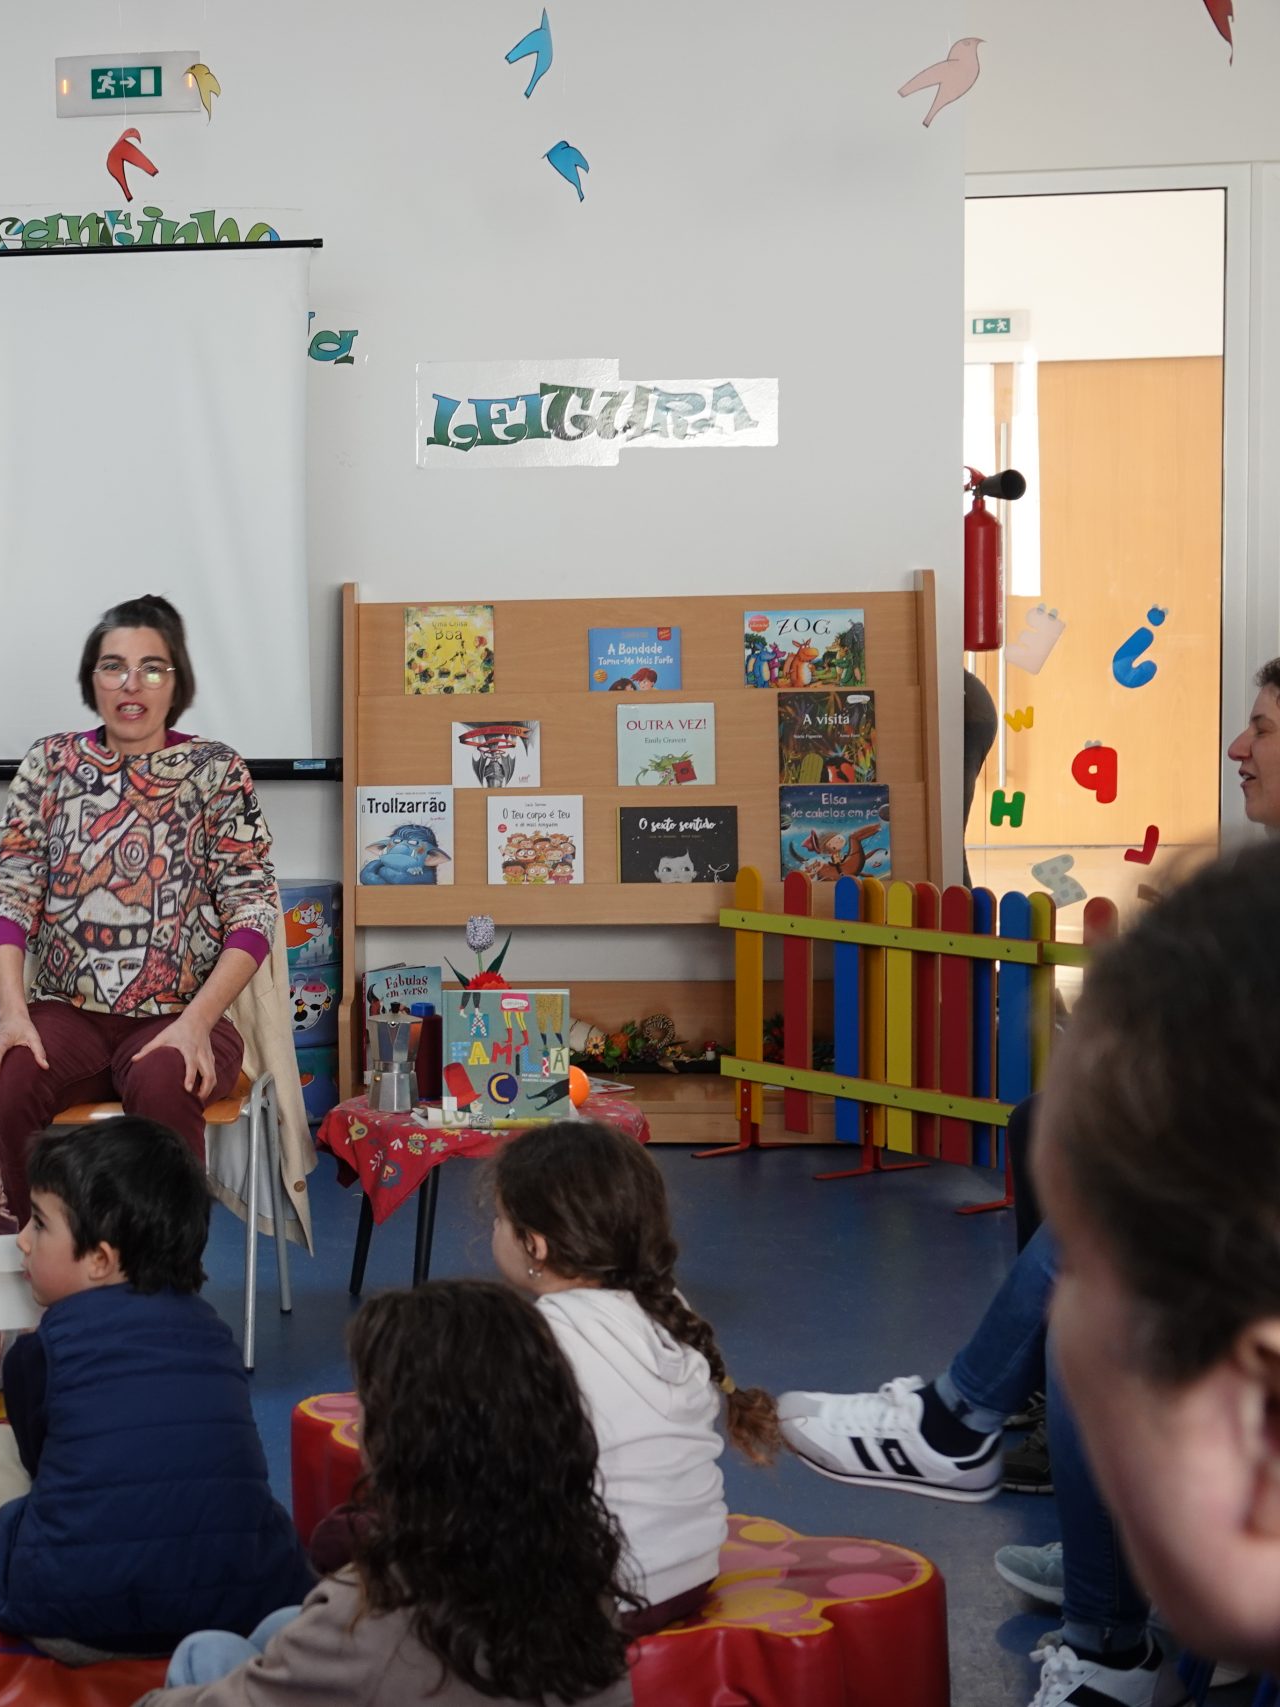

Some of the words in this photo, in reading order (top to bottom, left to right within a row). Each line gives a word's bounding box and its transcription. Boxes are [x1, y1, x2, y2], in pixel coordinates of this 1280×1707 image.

[776, 617, 831, 636] ZOG
[607, 643, 616, 656] A
[618, 642, 663, 655] Bondade
[598, 656, 634, 666] Torna-Me
[636, 656, 653, 665] Mais
[654, 655, 674, 665] Forte
[626, 719, 674, 731] OUTRA
[678, 718, 707, 730] VEZ!
[802, 713, 812, 725] A
[816, 713, 850, 725] visita
[367, 796, 446, 814] Trollzarrão
[821, 792, 847, 805] Elsa
[502, 807, 508, 819] O
[526, 811, 547, 822] corpo
[549, 809, 555, 819] é
[791, 808, 803, 818] de
[805, 807, 846, 818] cabelos
[847, 809, 864, 817] em
[865, 804, 880, 819] pé
[639, 817, 648, 830] O
[651, 817, 677, 832] sexto
[679, 816, 716, 832] sentido
[385, 974, 428, 989] Fábulas
[386, 989, 399, 998] em
[403, 987, 429, 996] verso
